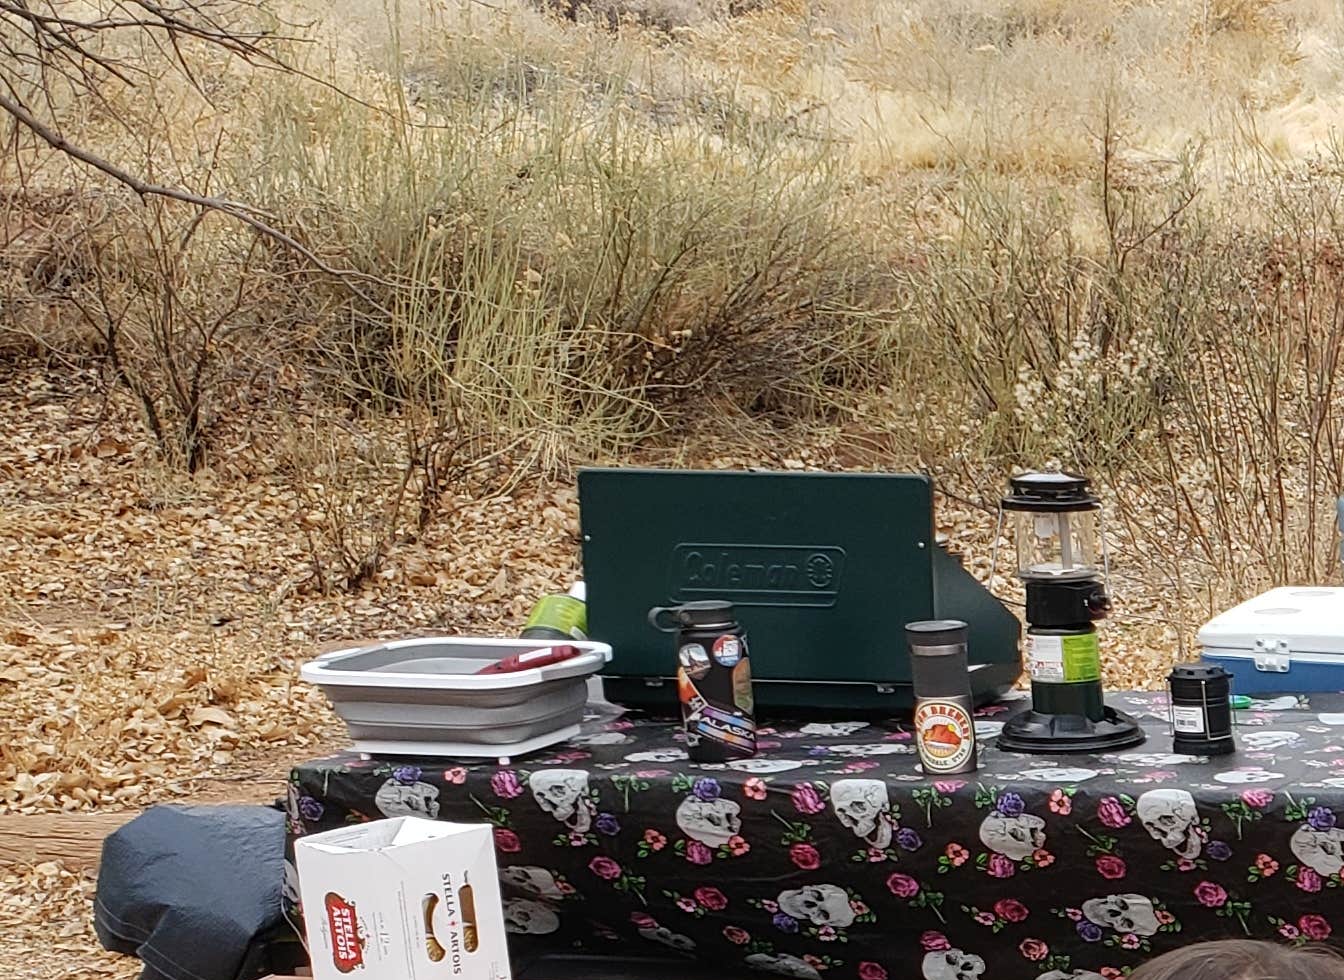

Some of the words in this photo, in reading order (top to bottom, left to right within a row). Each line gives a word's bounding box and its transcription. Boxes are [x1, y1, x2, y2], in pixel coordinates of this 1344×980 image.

[686, 551, 799, 584] Coleman
[700, 716, 755, 740] ALASKA
[331, 906, 348, 960] ARTOIS
[341, 907, 357, 960] STELLA
[441, 873, 456, 917] STELLA
[450, 931, 462, 975] ARTOIS
